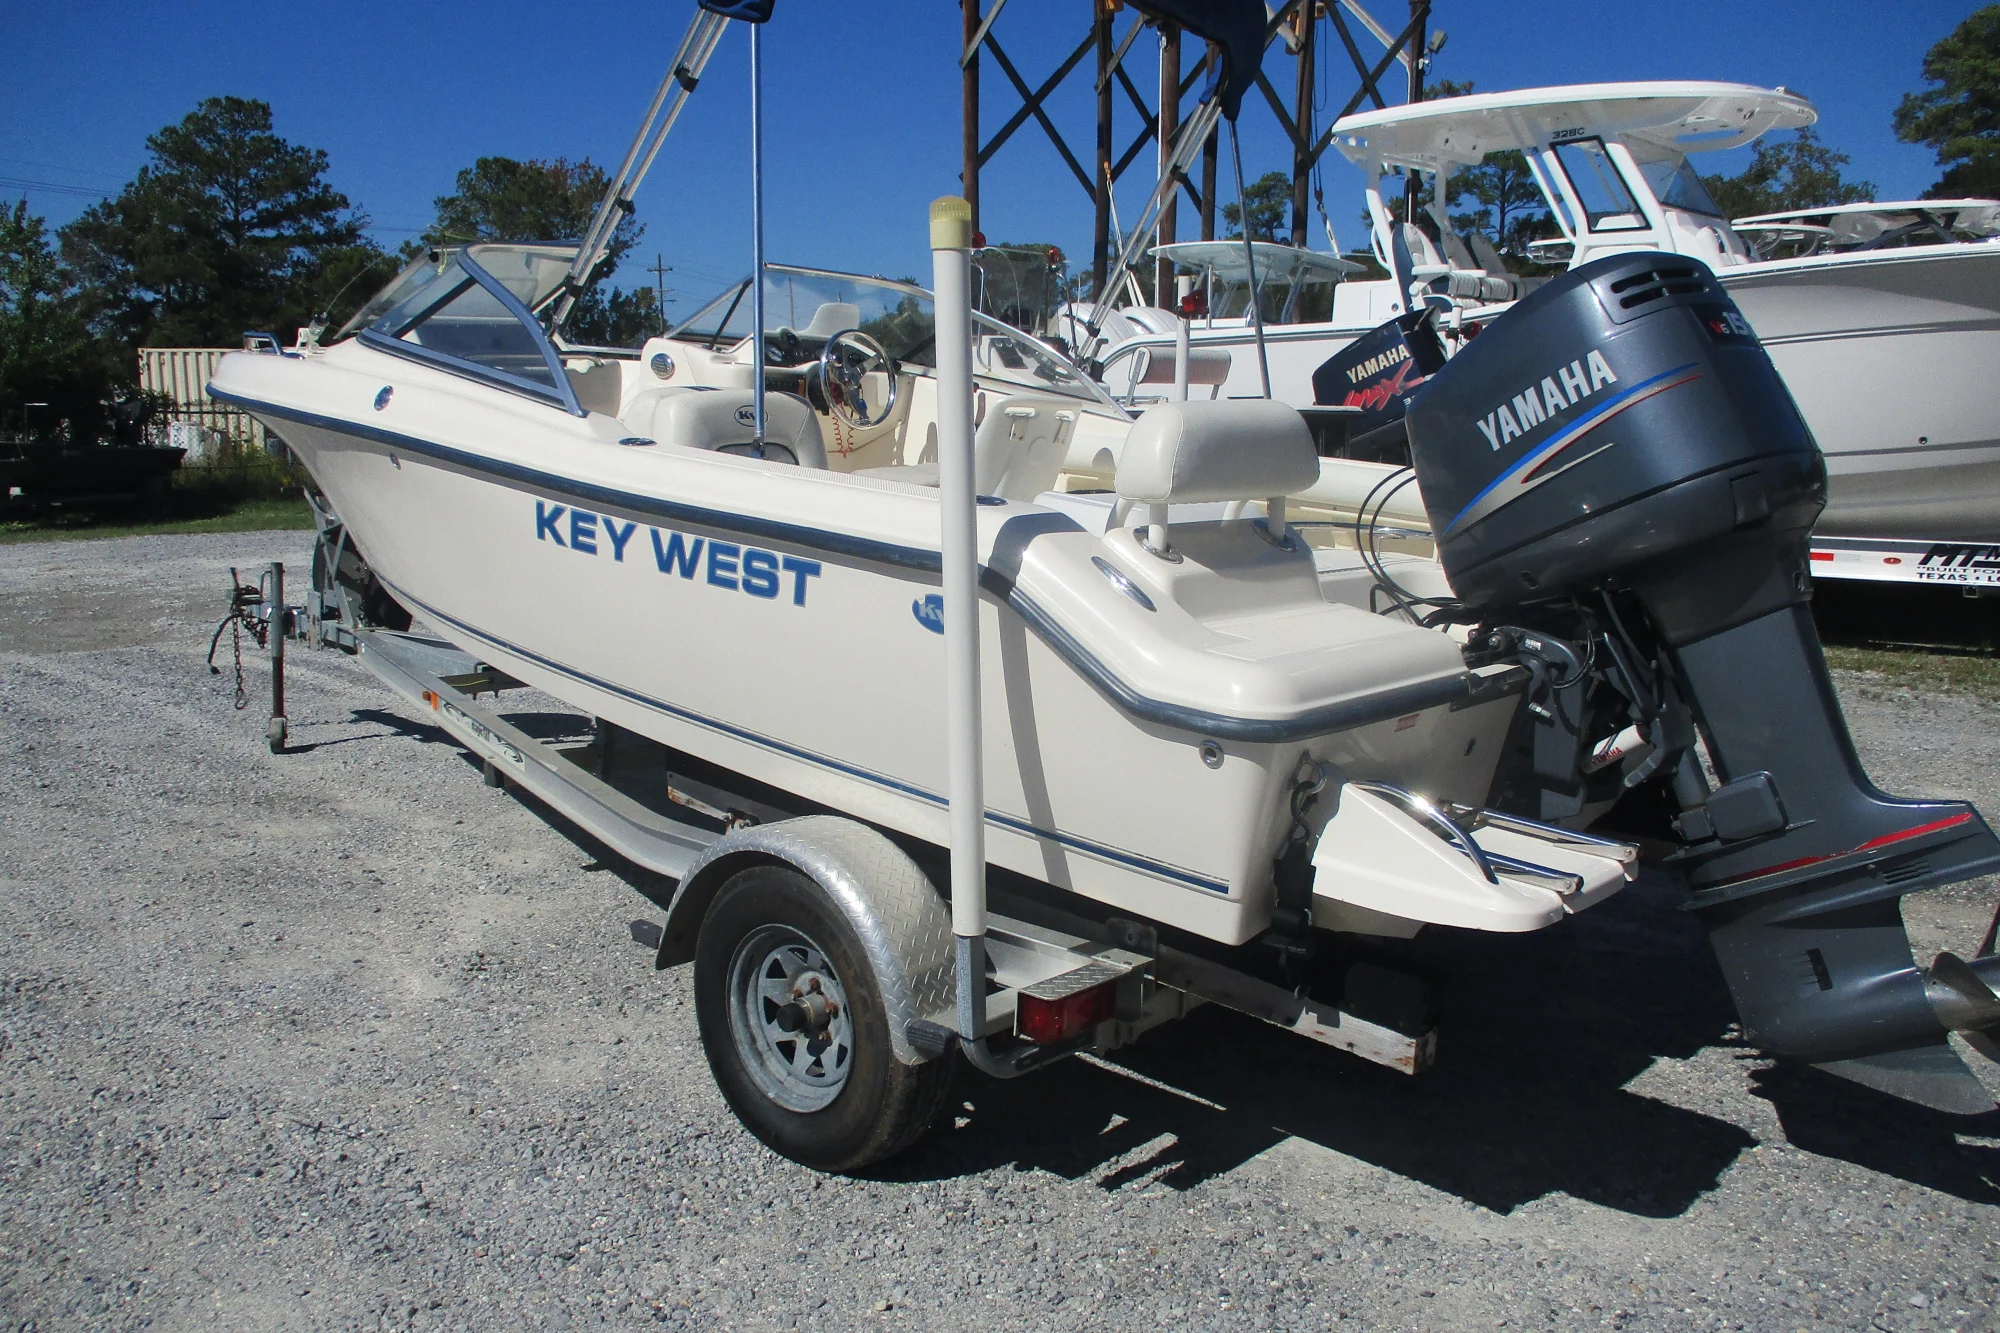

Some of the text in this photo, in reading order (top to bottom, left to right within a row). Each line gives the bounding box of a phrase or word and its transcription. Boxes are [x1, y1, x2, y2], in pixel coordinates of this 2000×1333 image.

[1346, 343, 1410, 384] YAMAHA
[1477, 349, 1617, 451] YAMAHA
[535, 499, 822, 608] KEY WEST
[1917, 572, 1968, 581] TEXAS
